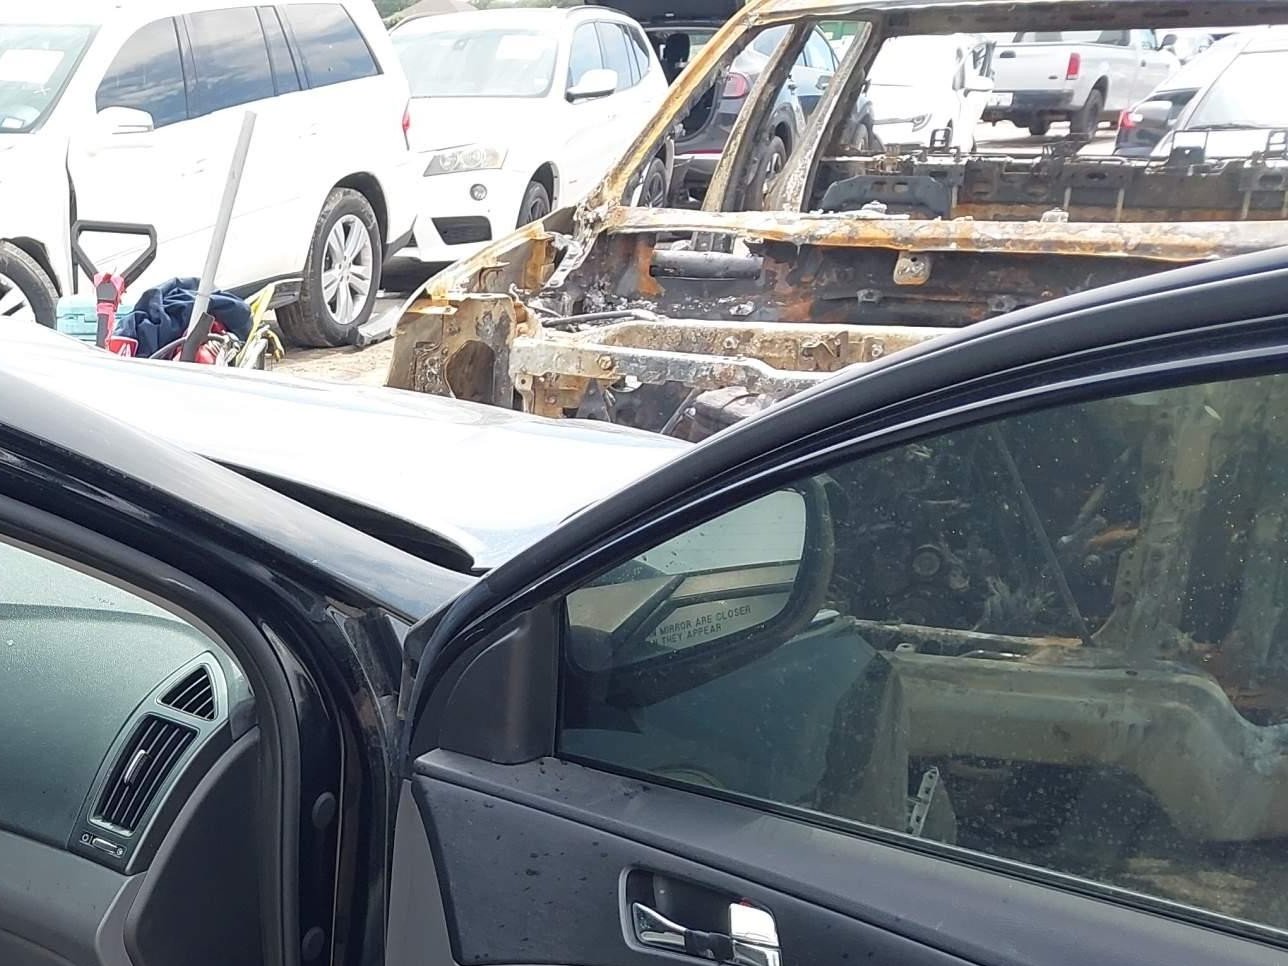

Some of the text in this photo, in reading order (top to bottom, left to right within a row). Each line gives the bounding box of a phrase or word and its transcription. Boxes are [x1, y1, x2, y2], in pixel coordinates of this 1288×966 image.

[695, 614, 713, 627] ARE
[715, 605, 752, 621] CLOSER
[662, 634, 683, 645] THEY
[687, 623, 722, 639] APPEAR
